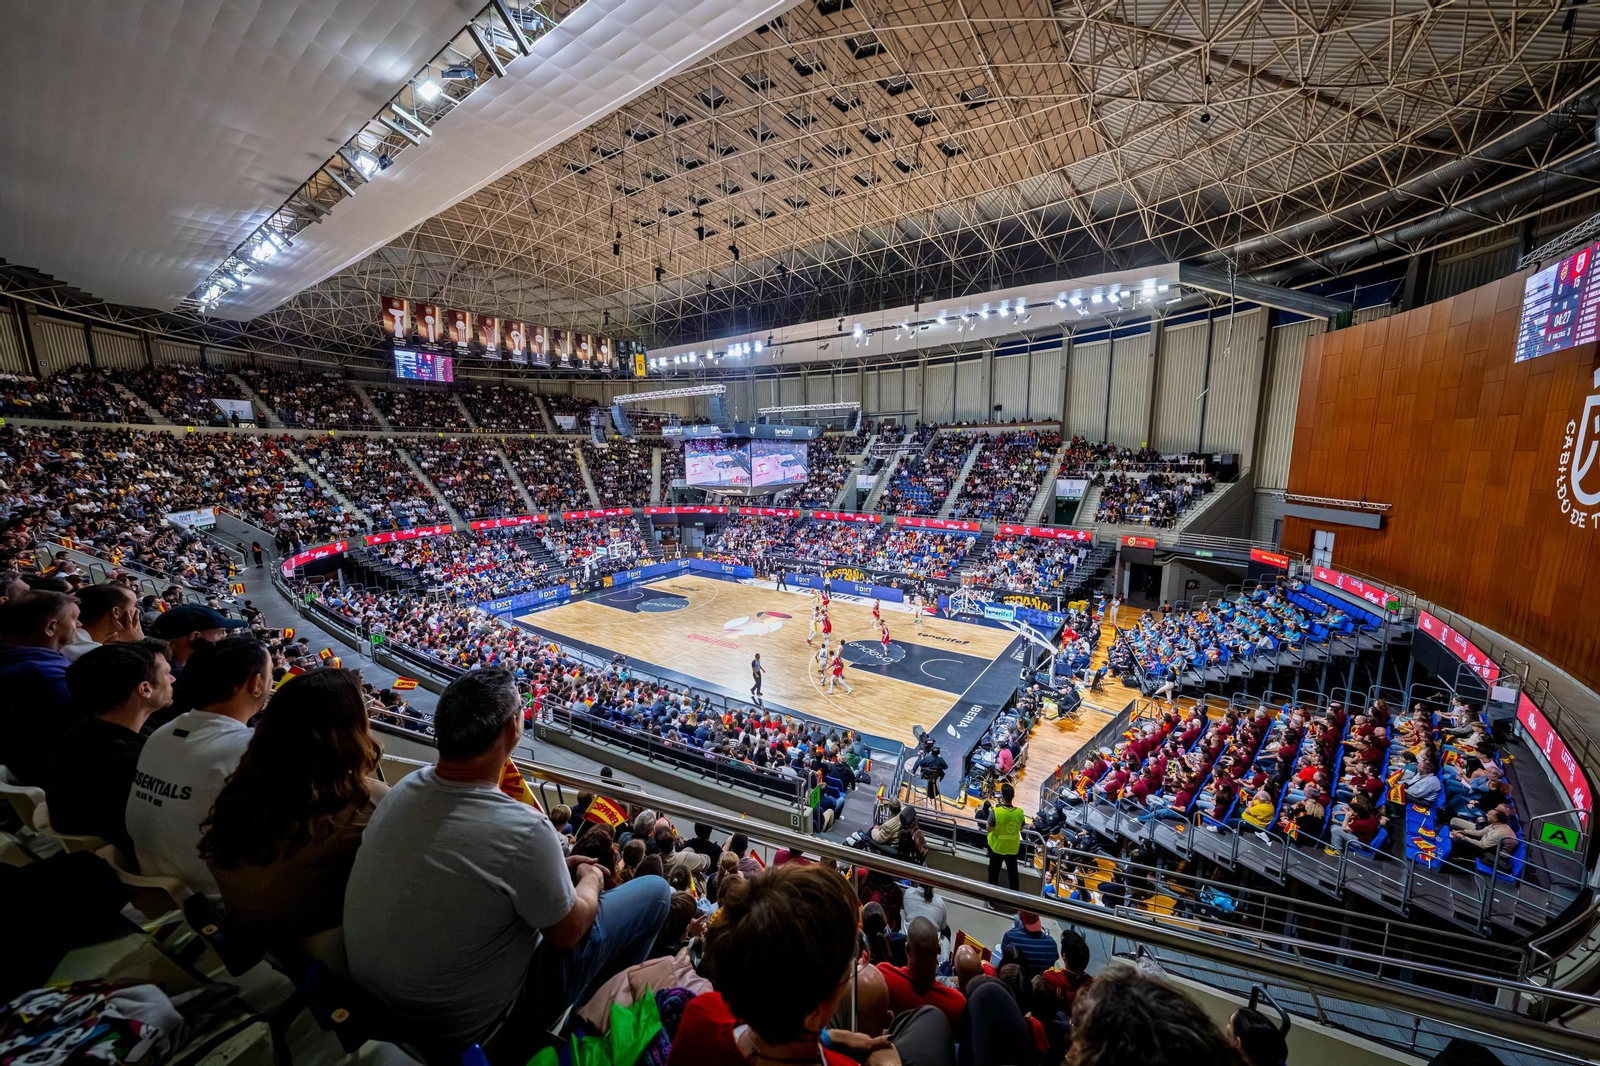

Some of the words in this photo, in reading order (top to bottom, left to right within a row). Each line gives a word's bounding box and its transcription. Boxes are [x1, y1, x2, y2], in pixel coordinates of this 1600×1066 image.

[1573, 275, 1581, 288] 15
[1553, 311, 1571, 328] 04:27
[1570, 508, 1588, 529] DE
[543, 588, 558, 597] DXT
[496, 599, 513, 608] DXT
[848, 641, 894, 663] endesa
[957, 704, 983, 728] IBERIA
[133, 770, 193, 800] SSENTIALS
[792, 815, 799, 825] B
[1547, 829, 1569, 845] A
